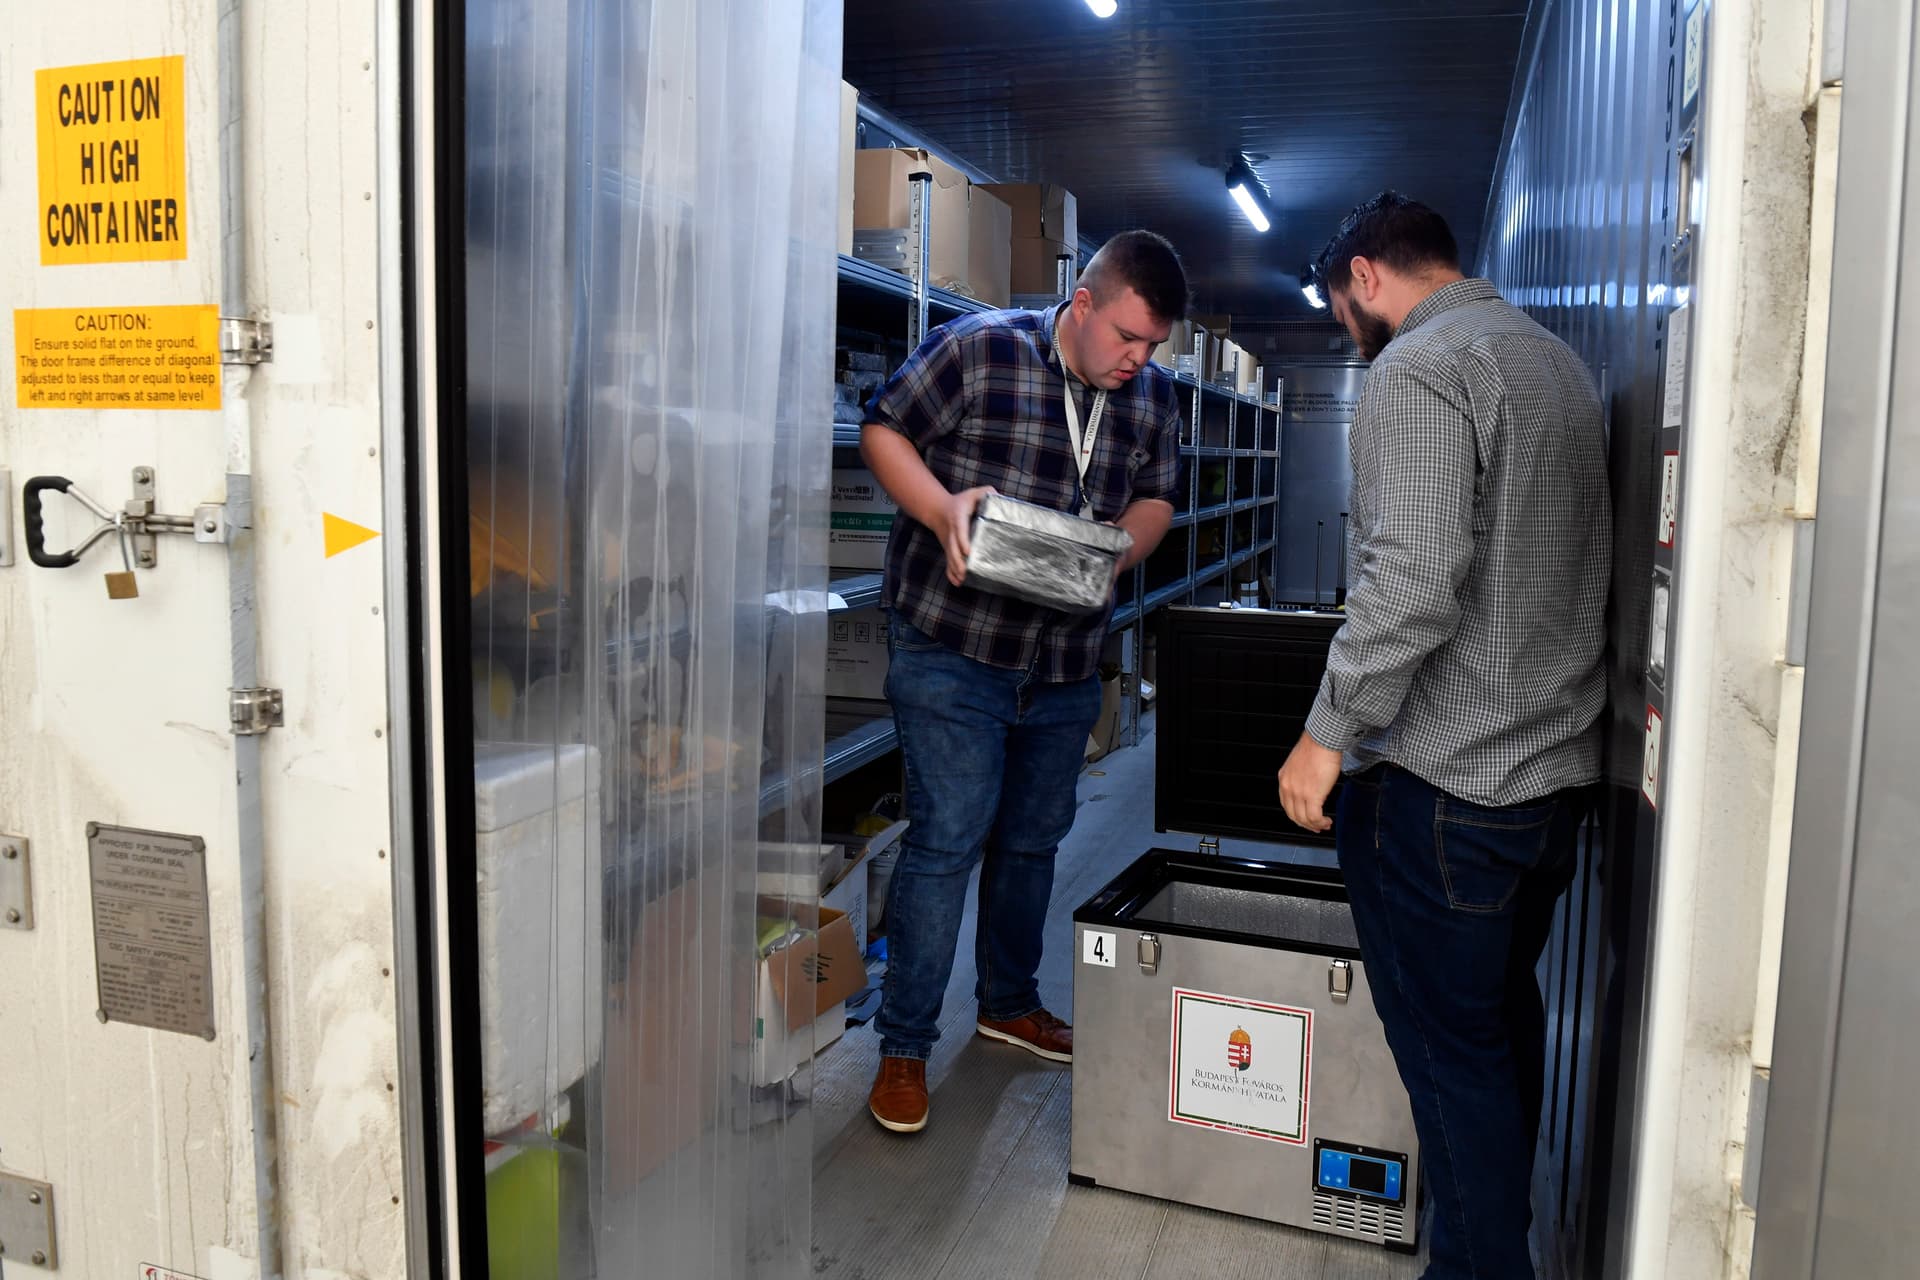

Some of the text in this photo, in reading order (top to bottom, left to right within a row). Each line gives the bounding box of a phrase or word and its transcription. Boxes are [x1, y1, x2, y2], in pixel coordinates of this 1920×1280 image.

[58, 76, 160, 127] CAUTION
[80, 139, 140, 185] HIGH
[47, 198, 179, 247] CONTAINER
[75, 314, 152, 332] CAUTION:
[34, 338, 70, 350] Ensure
[73, 337, 97, 350] solid
[100, 337, 116, 349] flat
[119, 339, 132, 349] on
[136, 337, 152, 349] the
[20, 353, 215, 369] The door frame difference of diagonal
[21, 371, 215, 387] adjusted to less than or equal to keep
[29, 389, 204, 404] left and right arrows at same level
[1093, 936, 1109, 963] 4.
